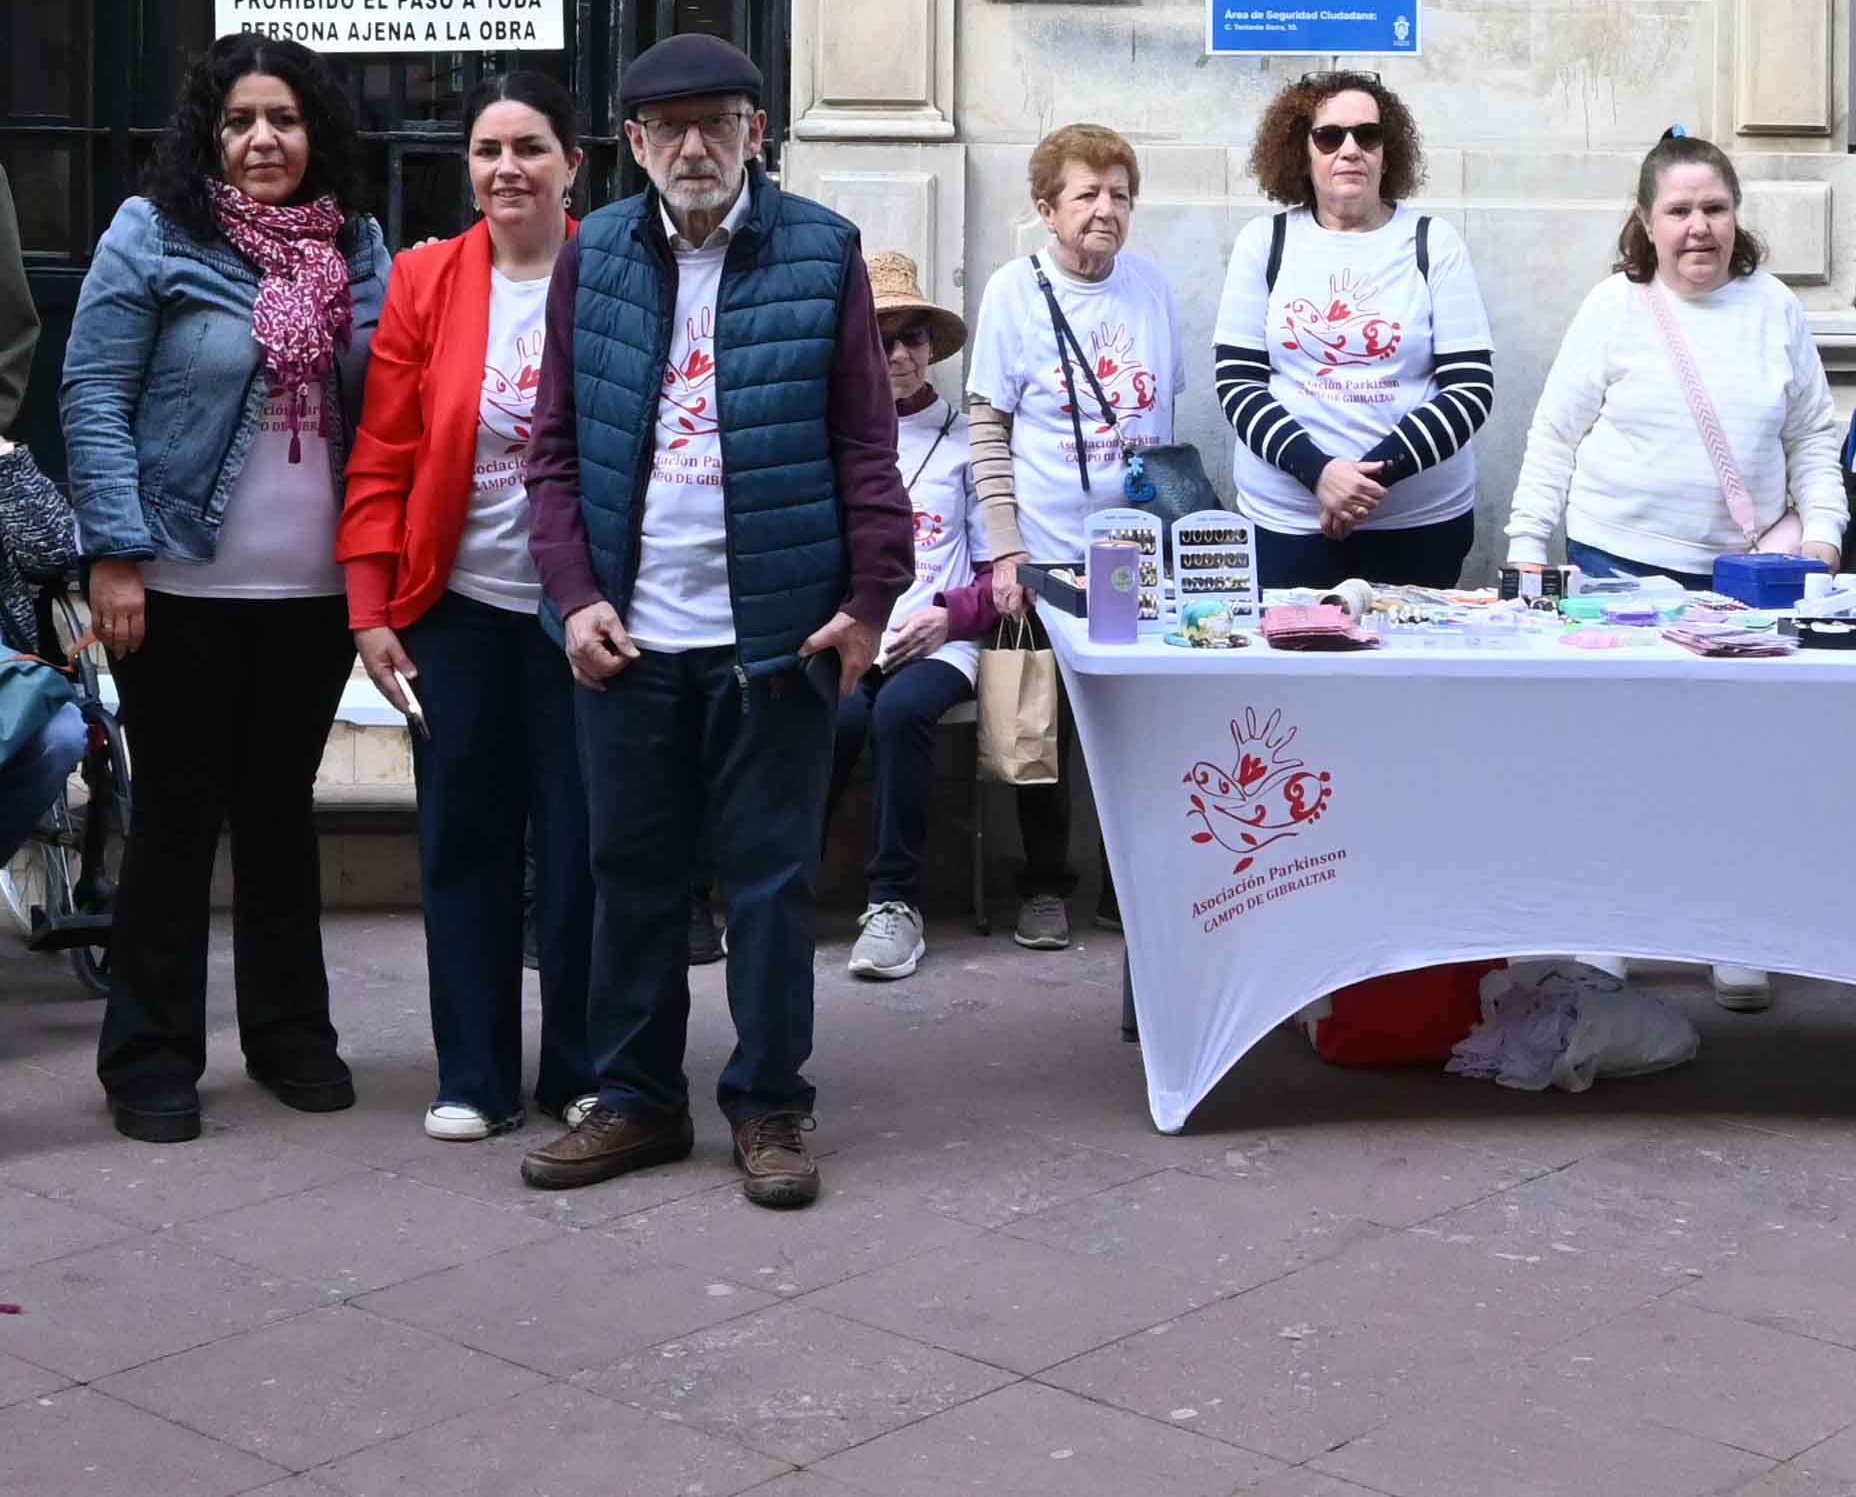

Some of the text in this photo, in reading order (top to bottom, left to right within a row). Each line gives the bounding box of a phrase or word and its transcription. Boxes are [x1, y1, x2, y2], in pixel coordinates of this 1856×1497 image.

[1224, 8, 1249, 20] Área
[1251, 10, 1263, 20] de
[1266, 10, 1318, 21] Seguridad
[348, 22, 416, 40] AJENA
[425, 22, 437, 40] A
[446, 21, 471, 40] LA
[480, 21, 536, 40] OBRA
[703, 454, 721, 468] Pa
[1065, 453, 1101, 463] CAPO
[676, 473, 693, 485] DE
[696, 474, 722, 486] GIB
[1192, 849, 1347, 918] Asociación Parkinson
[1204, 869, 1336, 934] CAMPO DE GIBRALTAR
